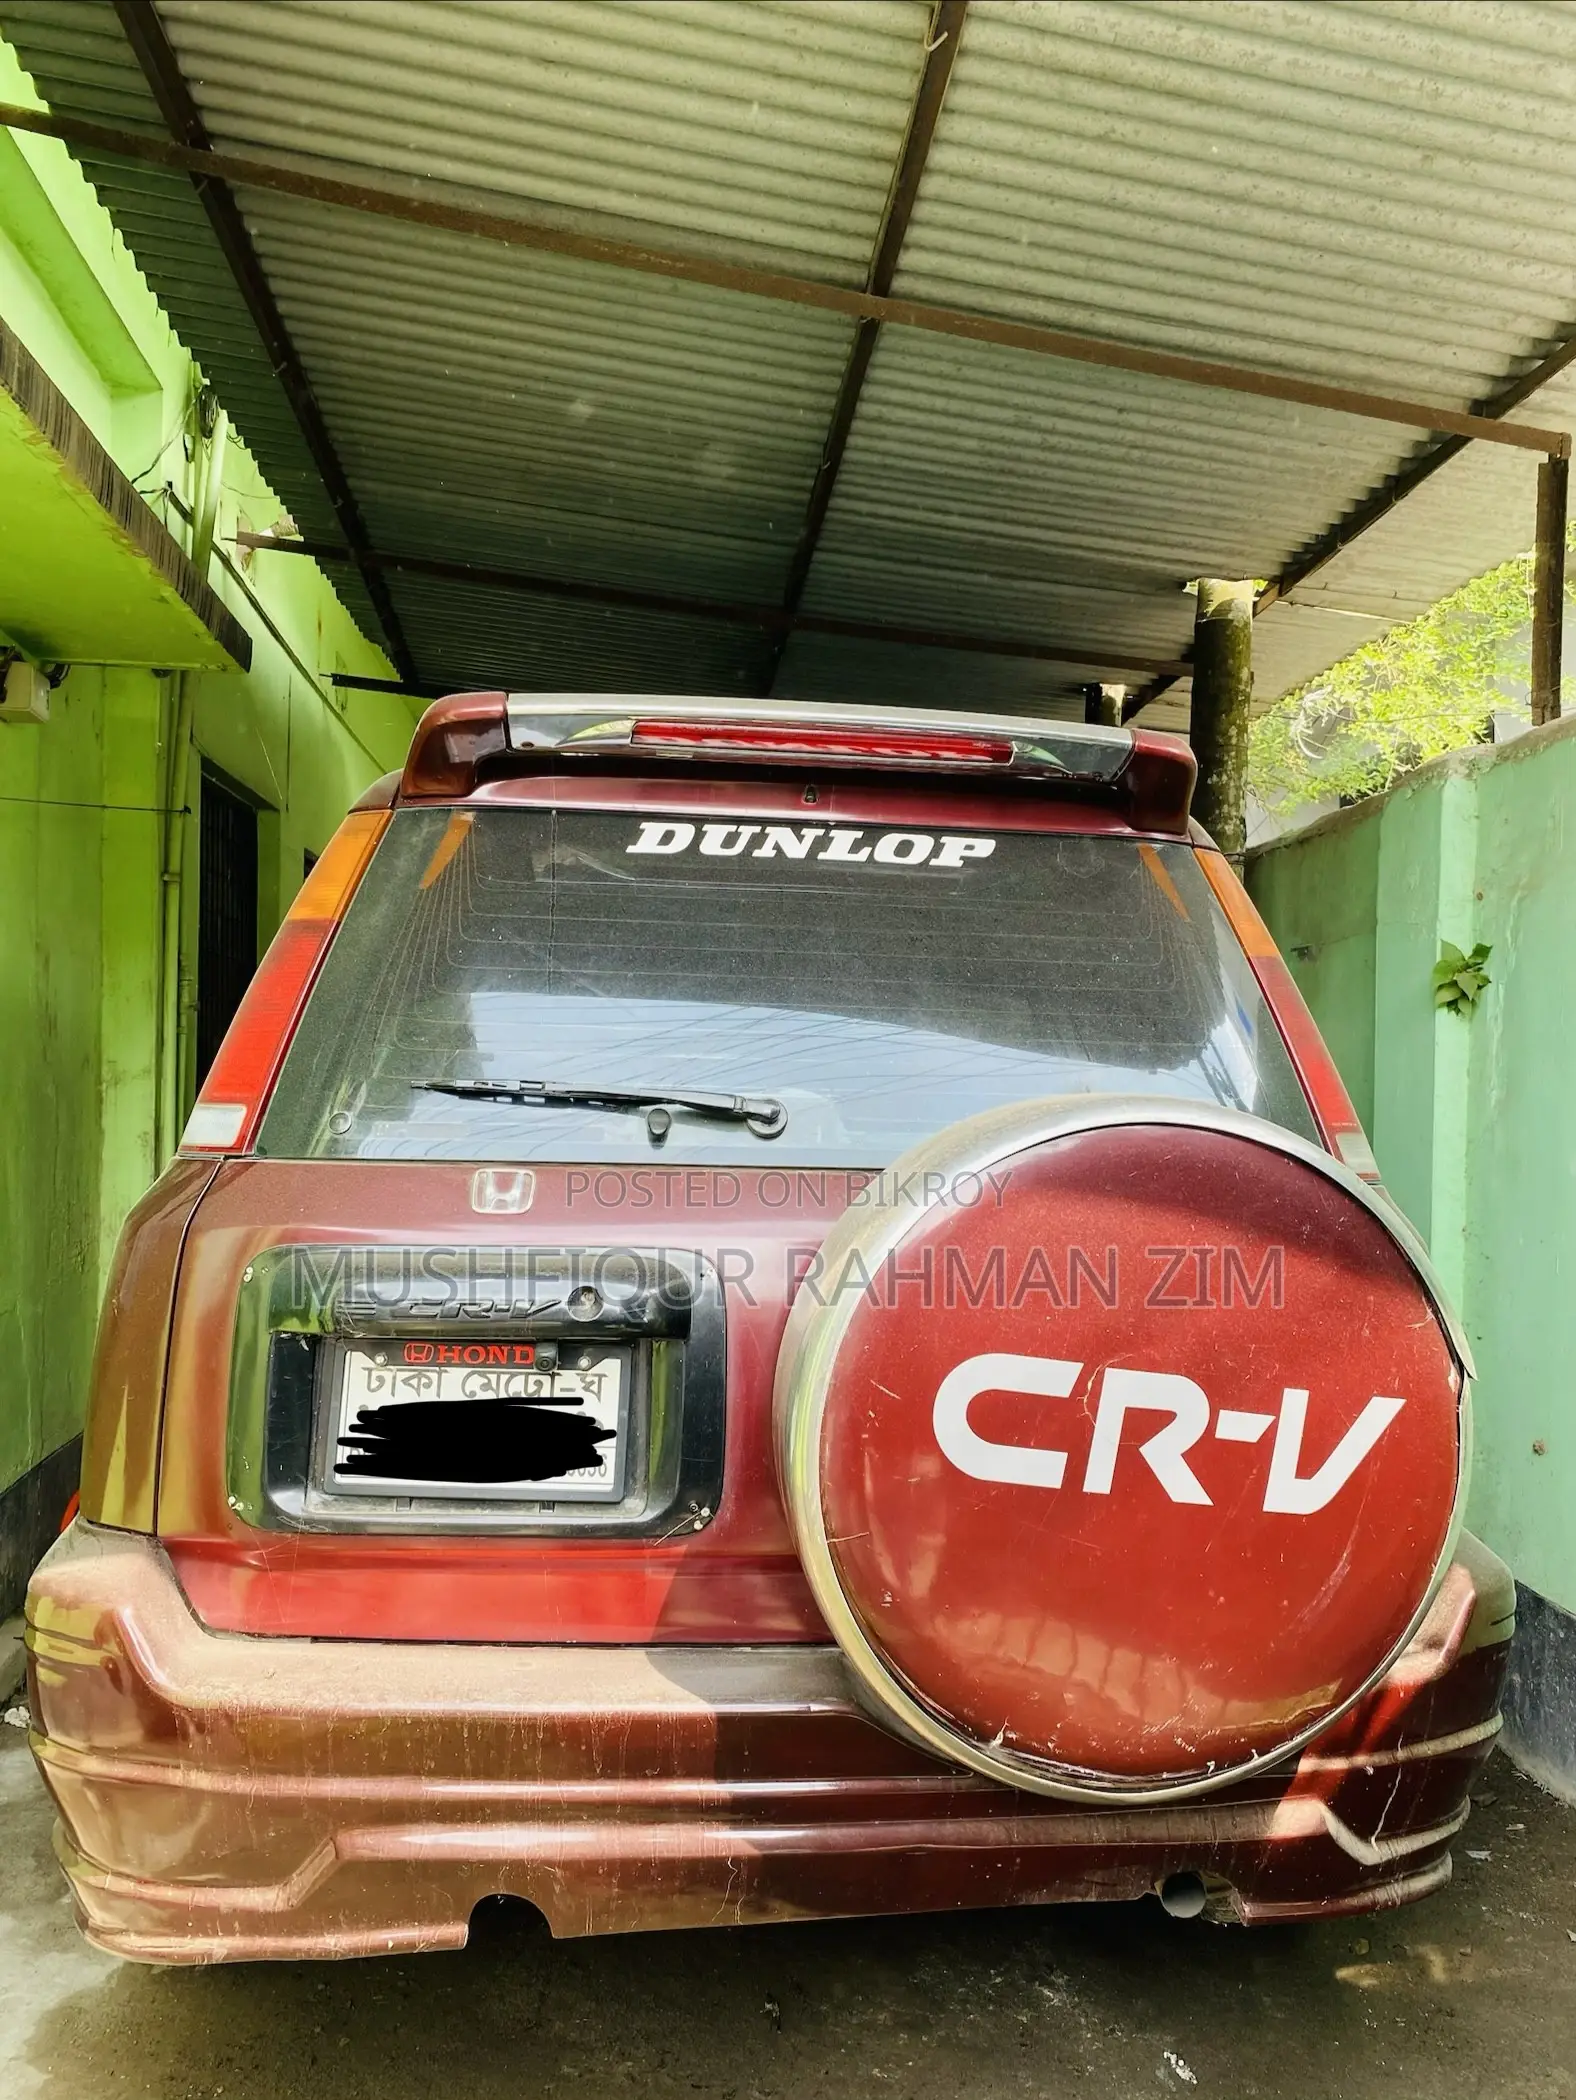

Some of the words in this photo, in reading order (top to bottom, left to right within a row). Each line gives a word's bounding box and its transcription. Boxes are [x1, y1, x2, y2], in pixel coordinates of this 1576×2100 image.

[625, 821, 997, 868] DUNLOP
[393, 1299, 562, 1319] CR-V
[436, 1345, 536, 1365] HOND
[361, 1366, 450, 1399] ঢাকা
[931, 1352, 1407, 1516] CR-V
